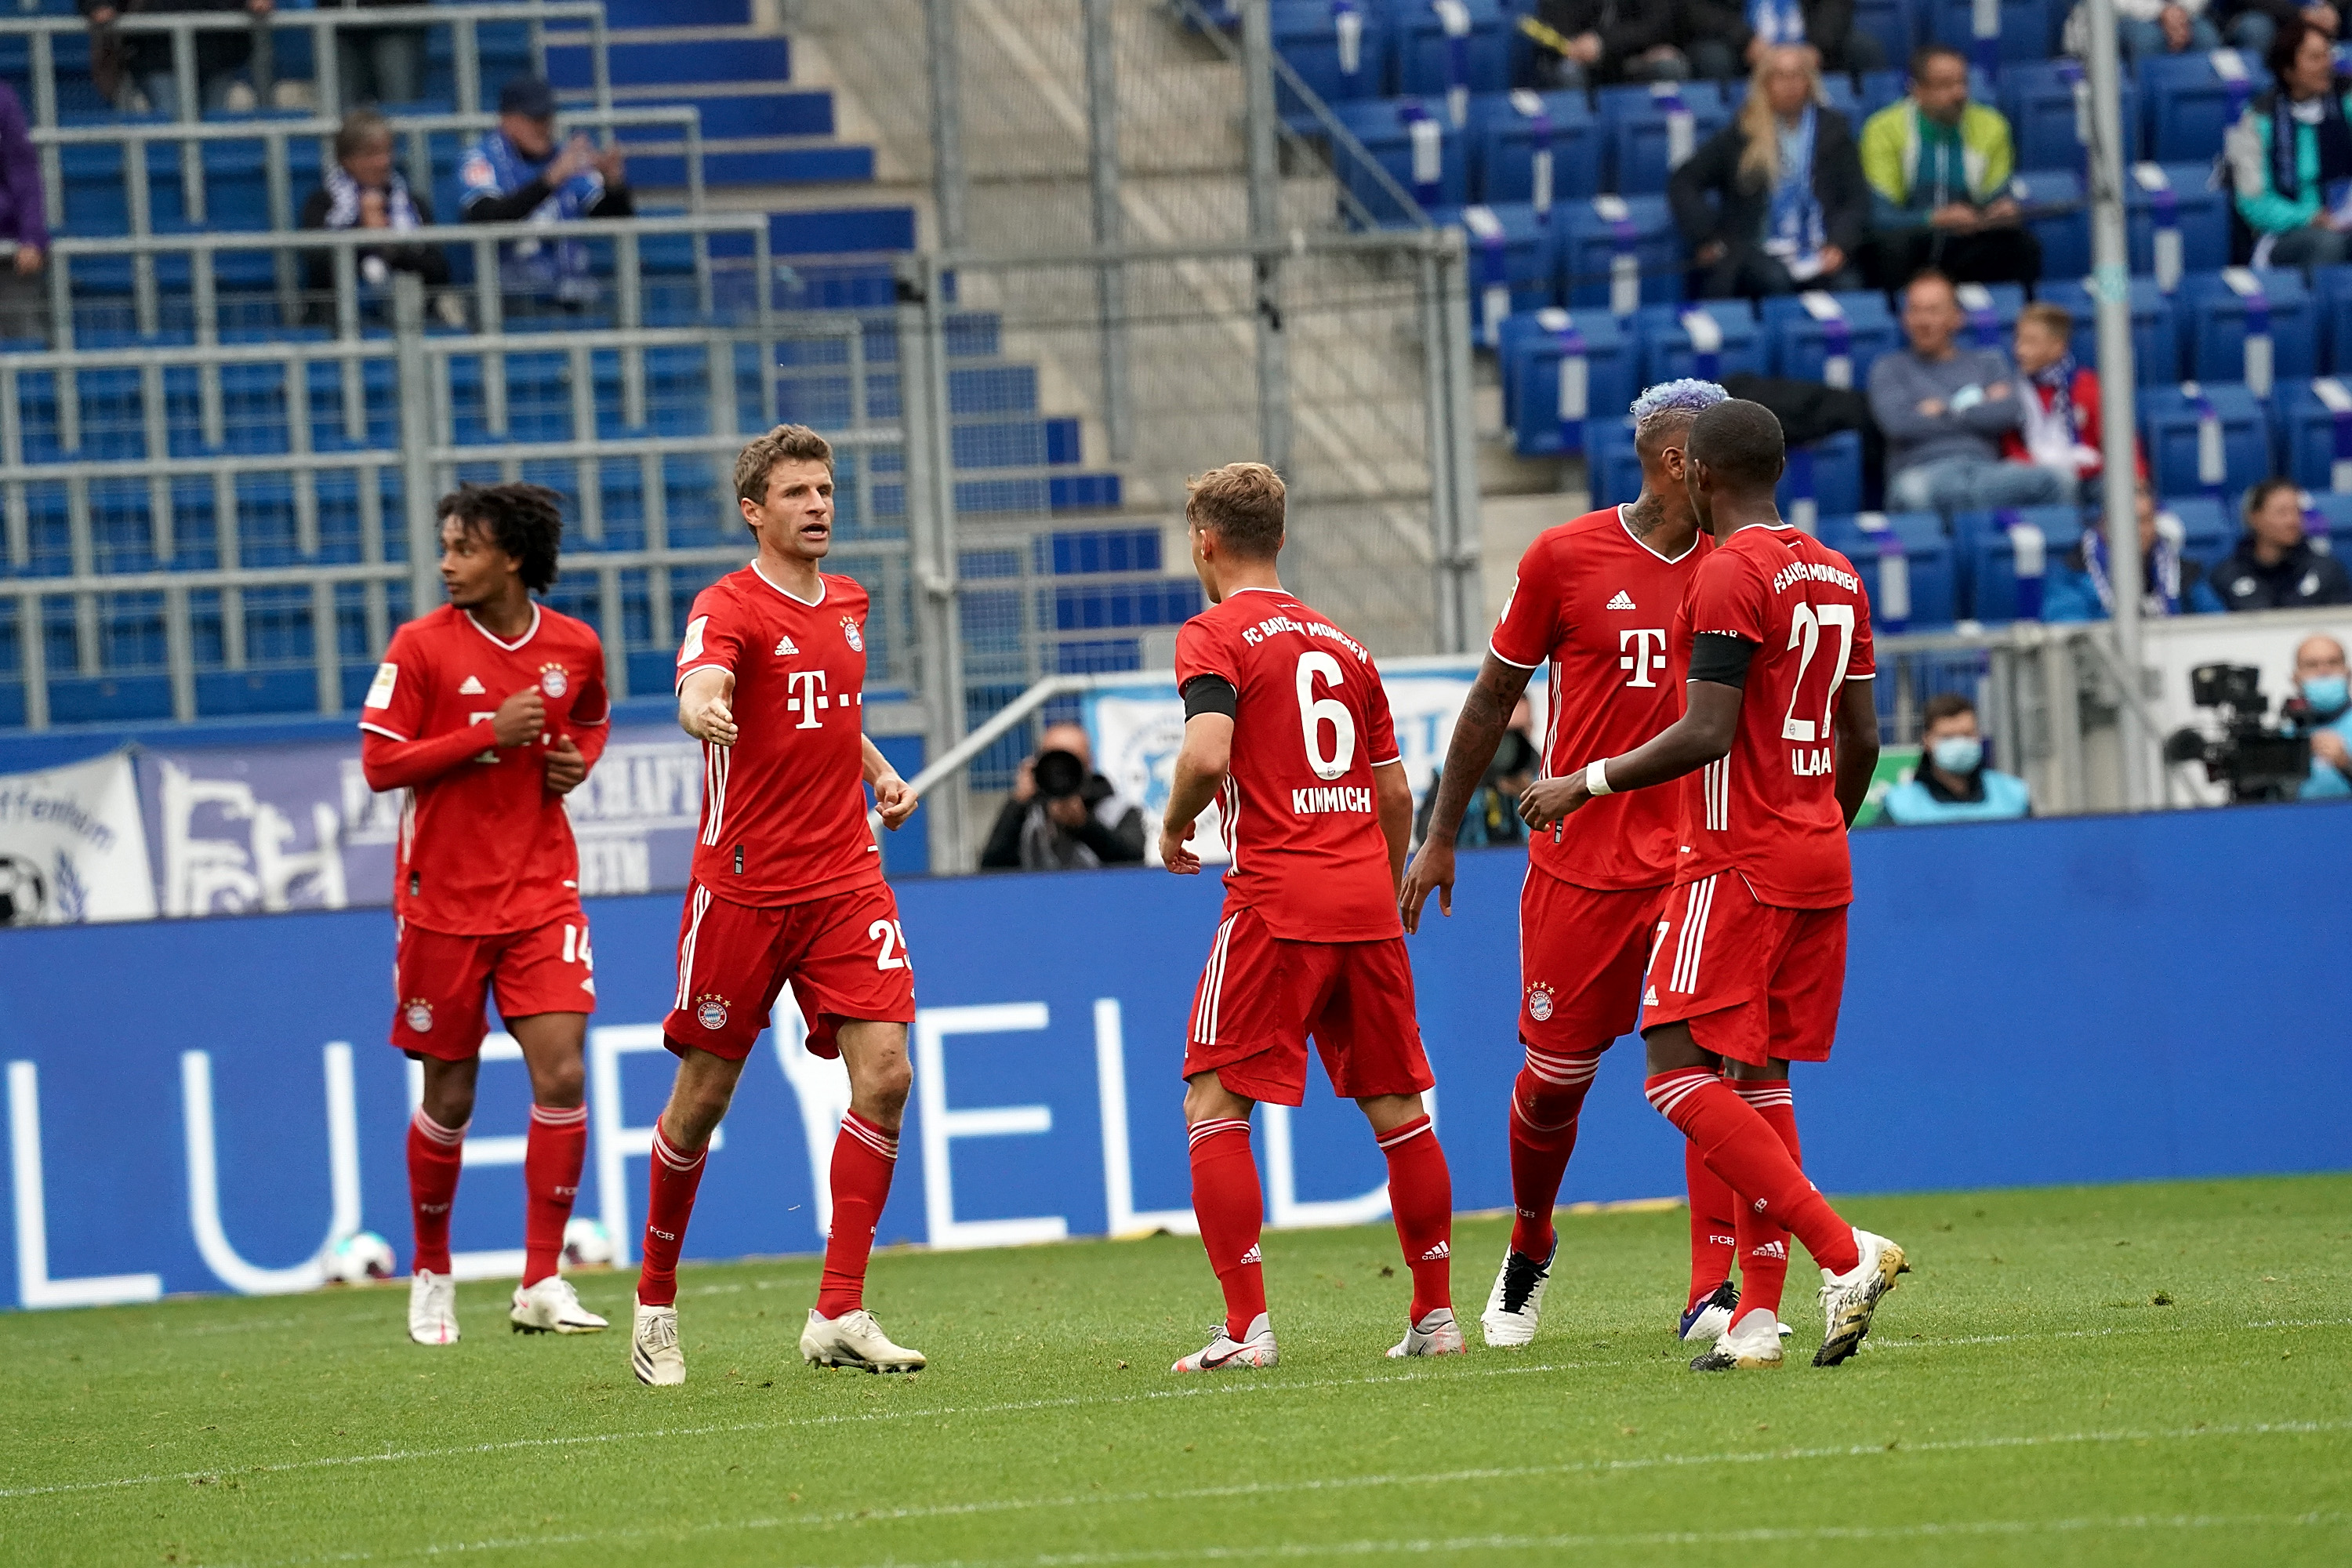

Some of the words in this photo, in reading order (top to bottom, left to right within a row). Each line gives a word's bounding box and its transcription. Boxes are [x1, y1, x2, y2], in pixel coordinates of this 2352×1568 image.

[1773, 572, 1787, 594] FC
[1606, 601, 1636, 610] adidas
[1242, 627, 1264, 647] FC
[1781, 601, 1854, 742] 27
[1295, 651, 1356, 781] 6
[1292, 786, 1371, 815] KIMMICH
[650, 1225, 675, 1241] FCB
[1709, 1235, 1735, 1247] FCB
[1752, 1249, 1786, 1261] adidas
